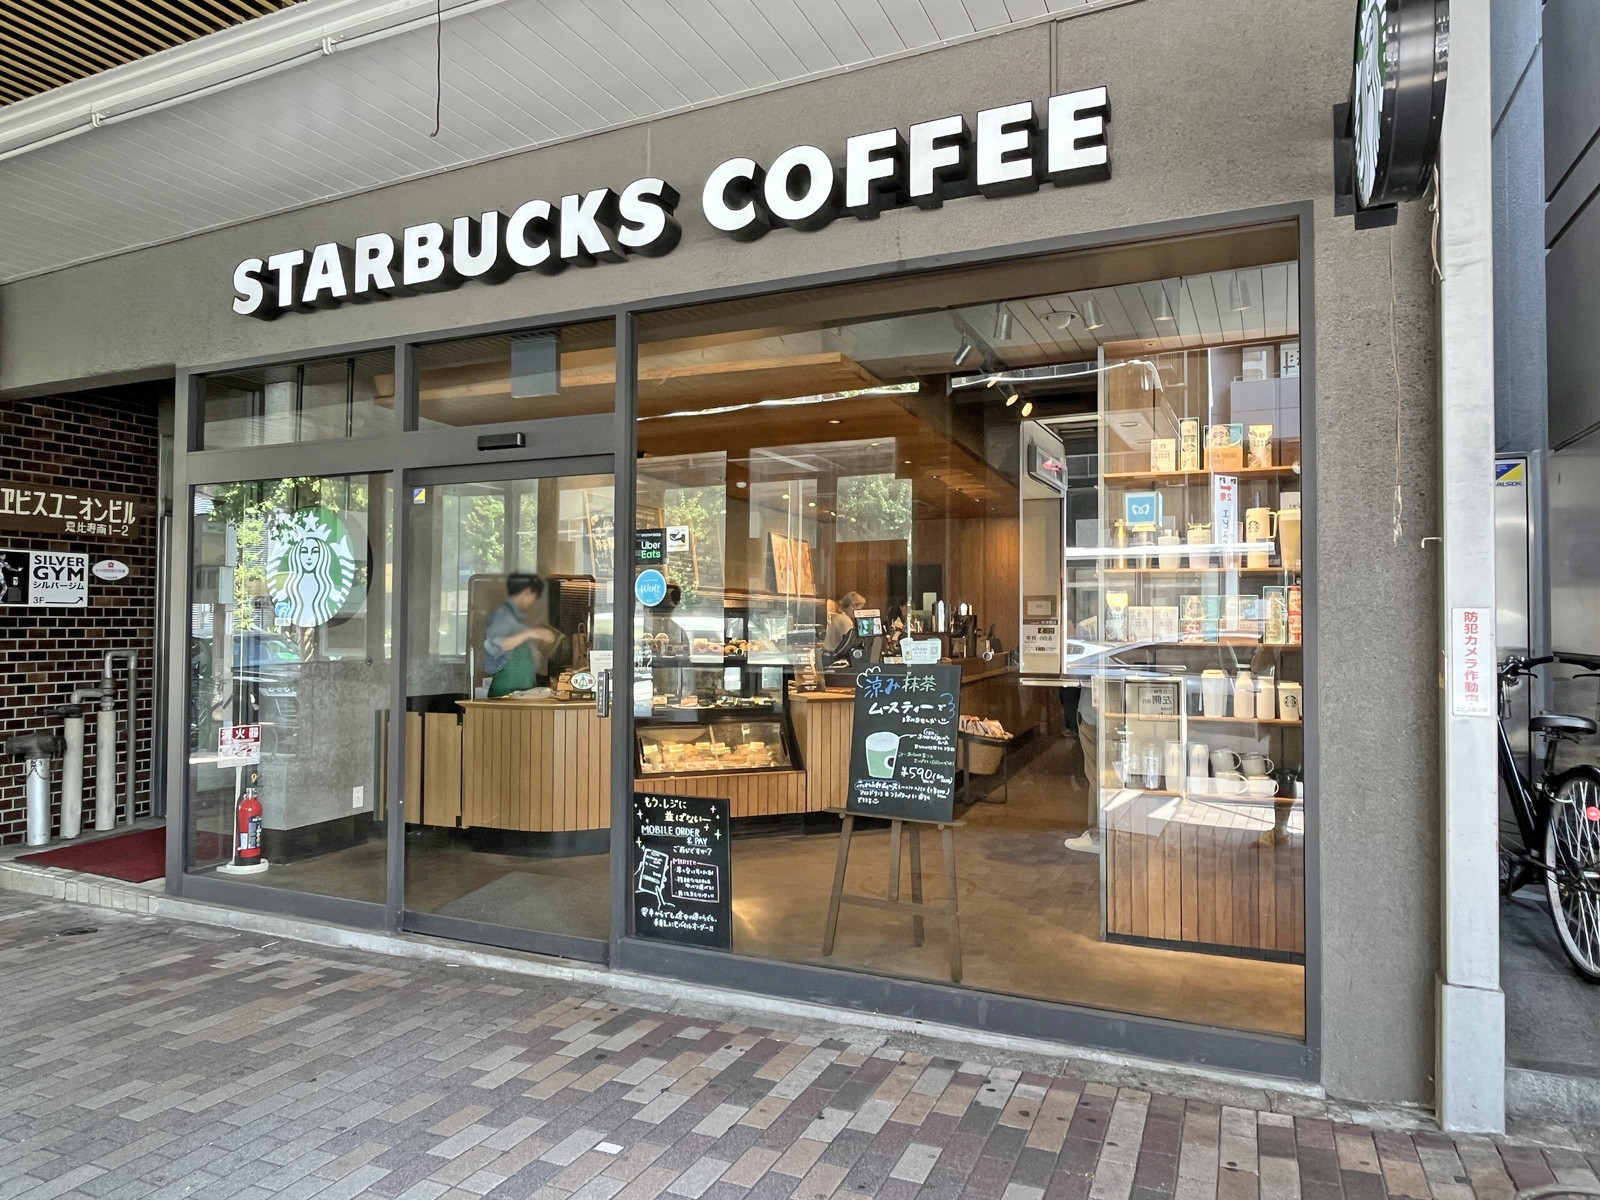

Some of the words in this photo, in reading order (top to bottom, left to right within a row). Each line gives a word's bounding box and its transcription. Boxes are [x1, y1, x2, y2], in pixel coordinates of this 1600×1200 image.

[232, 177, 670, 316] STARBUCKS
[702, 85, 1109, 232] COFFEE
[641, 541, 661, 550] Uber
[641, 550, 661, 559] Eats
[34, 555, 85, 567] SILVER
[33, 566, 85, 582] GYM
[33, 581, 85, 590] シルバージム
[640, 584, 661, 594] Wolt
[33, 596, 45, 604] 3F
[1463, 611, 1479, 703] 防犯カメラ作動中
[641, 825, 673, 835] MOBILE
[675, 826, 701, 837] ORDER
[694, 837, 708, 846] PAY
